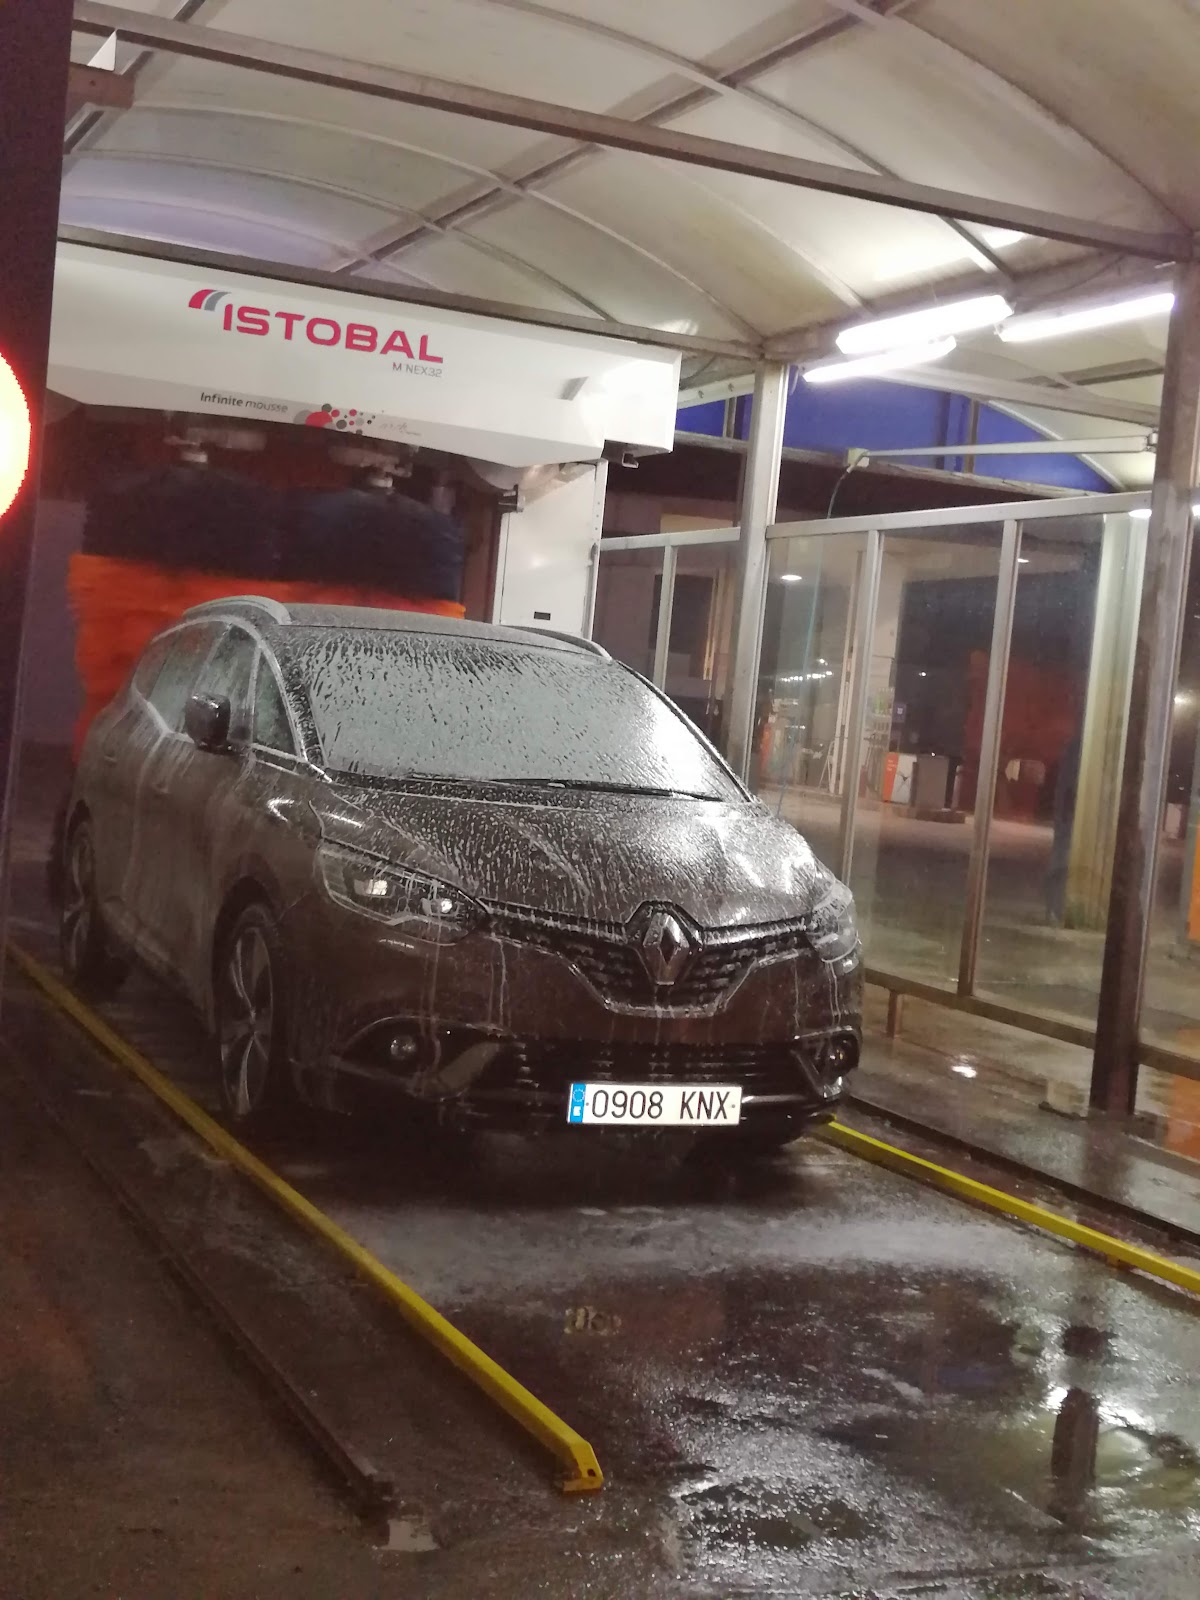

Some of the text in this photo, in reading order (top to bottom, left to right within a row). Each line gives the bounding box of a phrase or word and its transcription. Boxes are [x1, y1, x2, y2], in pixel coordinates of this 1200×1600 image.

[222, 303, 444, 364] ISTOBAL
[200, 392, 289, 413] Infinite mousse
[591, 1089, 731, 1120] 0908 KNX
